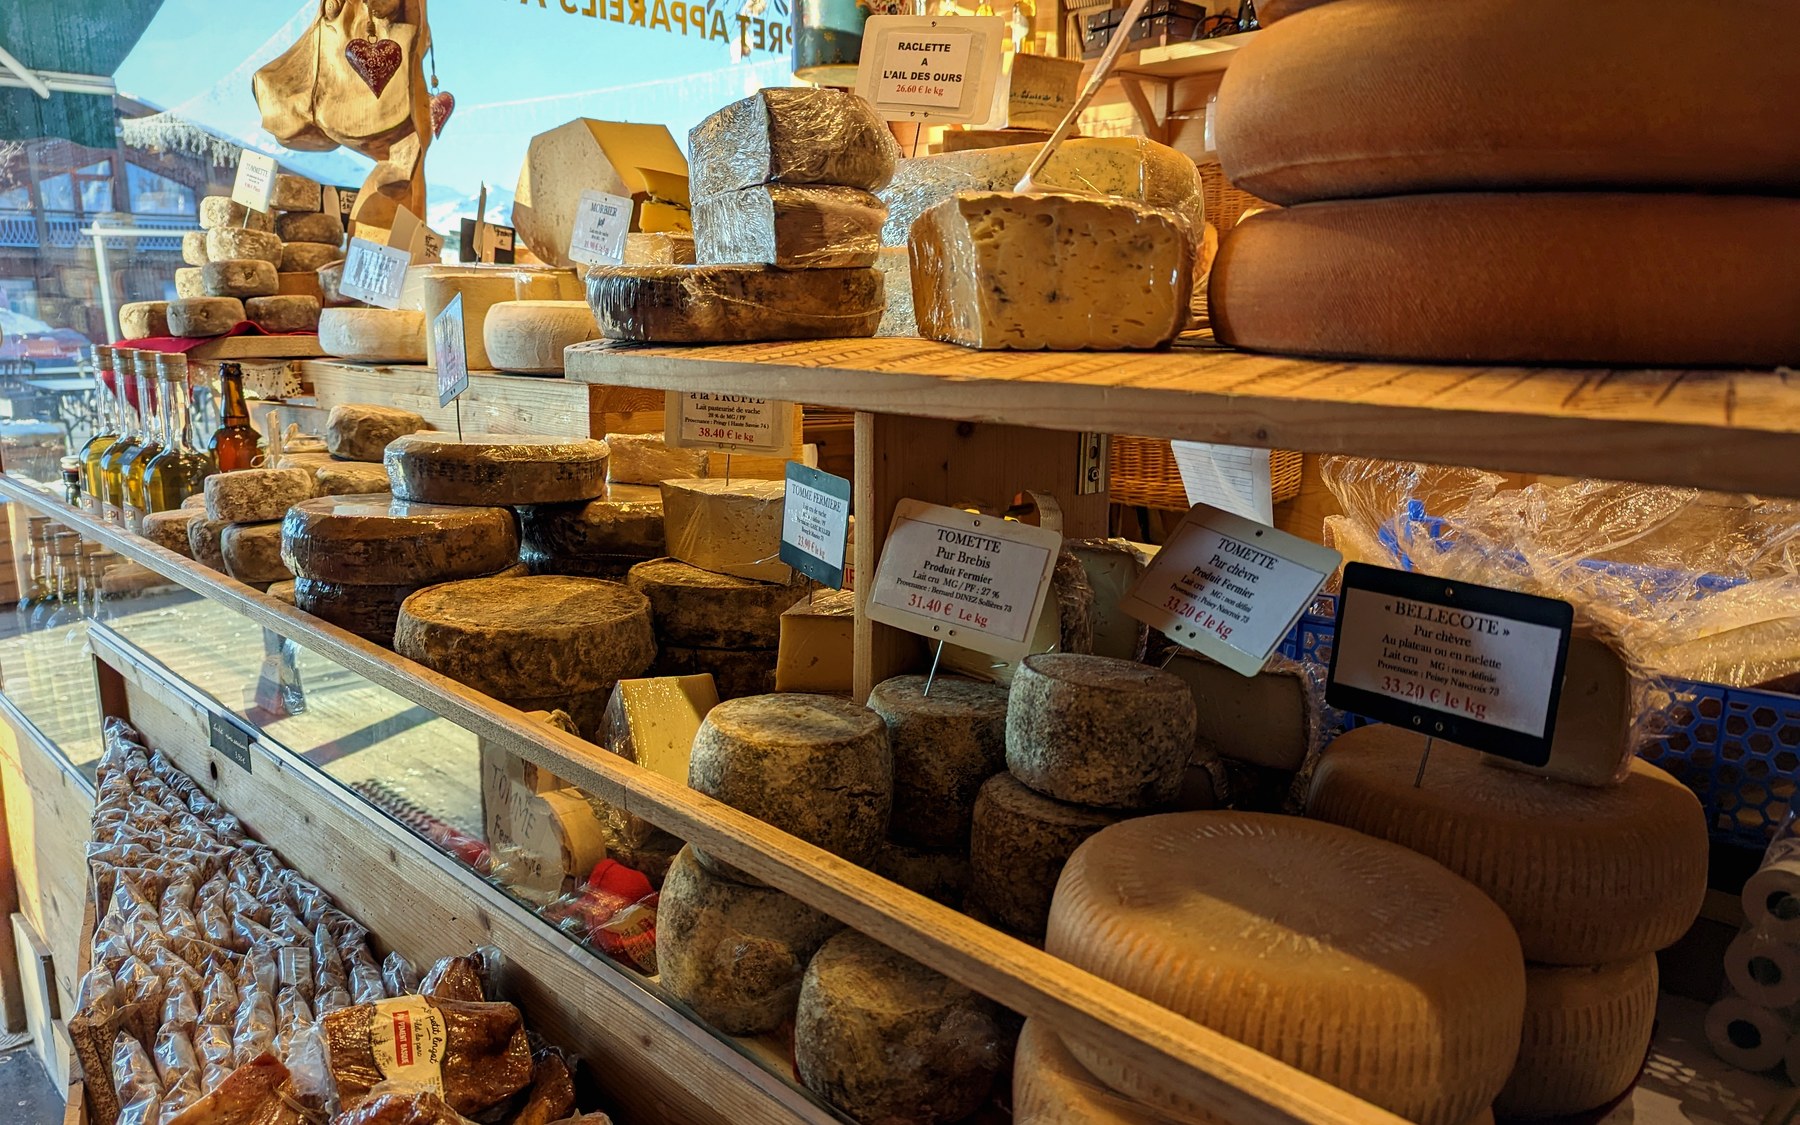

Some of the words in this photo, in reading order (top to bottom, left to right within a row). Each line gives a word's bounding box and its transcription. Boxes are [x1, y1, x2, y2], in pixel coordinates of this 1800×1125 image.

[898, 42, 951, 52] RACLETTE
[883, 70, 908, 80] L'AIL
[910, 72, 930, 80] DES
[933, 73, 962, 82] OURS
[896, 84, 916, 93] 26.60
[934, 86, 944, 96] kg
[591, 202, 618, 217] MORBIER
[698, 428, 724, 438] 38.40
[727, 430, 733, 439] €
[735, 432, 743, 440] le
[744, 432, 754, 442] kg
[792, 484, 812, 501] TOMME
[813, 492, 841, 512] FERMIERE
[937, 528, 1001, 554] TOMETTE
[1218, 538, 1279, 570] TOMETTE
[936, 546, 956, 560] Pur
[958, 552, 991, 569] Brebis
[1208, 554, 1227, 569] Pur
[1226, 563, 1259, 584] chèvre
[912, 570, 928, 582] Lait
[928, 574, 940, 584] cru
[942, 578, 958, 588] MG
[959, 582, 964, 590] /
[964, 582, 976, 592] PF
[981, 586, 992, 596] 27
[992, 589, 1000, 599] %
[923, 560, 956, 576] Produit
[957, 568, 993, 585] Fermier
[1192, 566, 1222, 584] Produit
[1221, 578, 1255, 599] Fermier
[896, 577, 927, 592] Provenance
[931, 586, 955, 599] Bernard
[1003, 604, 1012, 613] 73
[1170, 583, 1198, 601] Provenance
[1240, 615, 1251, 624] 73
[1181, 574, 1194, 586] Lait
[1194, 582, 1205, 592] cru
[1210, 589, 1222, 598] MG
[1224, 597, 1236, 606] non
[908, 593, 942, 613] 31.40
[944, 603, 954, 616] €
[958, 608, 973, 621] Le
[974, 612, 988, 628] kg
[1163, 596, 1196, 618] 33.20
[1194, 610, 1206, 623] €
[1202, 614, 1216, 629] le
[1215, 620, 1234, 640] kg
[1395, 601, 1500, 636] BELLECOTE
[1502, 628, 1510, 636] »
[1413, 625, 1434, 638] Pur
[1435, 630, 1472, 647] chèvre
[1382, 634, 1396, 645] Au
[1399, 638, 1432, 654] plateau
[1434, 647, 1447, 658] ou
[1450, 651, 1462, 660] en
[1465, 654, 1502, 670] raclette
[1383, 647, 1401, 660] Lait
[1403, 654, 1418, 665] cru
[1430, 660, 1445, 671] MG
[1451, 666, 1467, 676] non
[1469, 669, 1497, 683] définie
[1377, 660, 1418, 677] Provenance
[1425, 671, 1448, 685] Peisey
[1450, 677, 1486, 693] Nancroix
[1489, 686, 1500, 697] 73
[1381, 675, 1425, 700] 33.20
[1430, 688, 1441, 703] €
[1444, 691, 1459, 708] le
[1464, 697, 1487, 720] kg
[398, 1022, 407, 1042] PIMENT
[425, 1016, 441, 1035] petit
[400, 1044, 409, 1064] BASQUE
